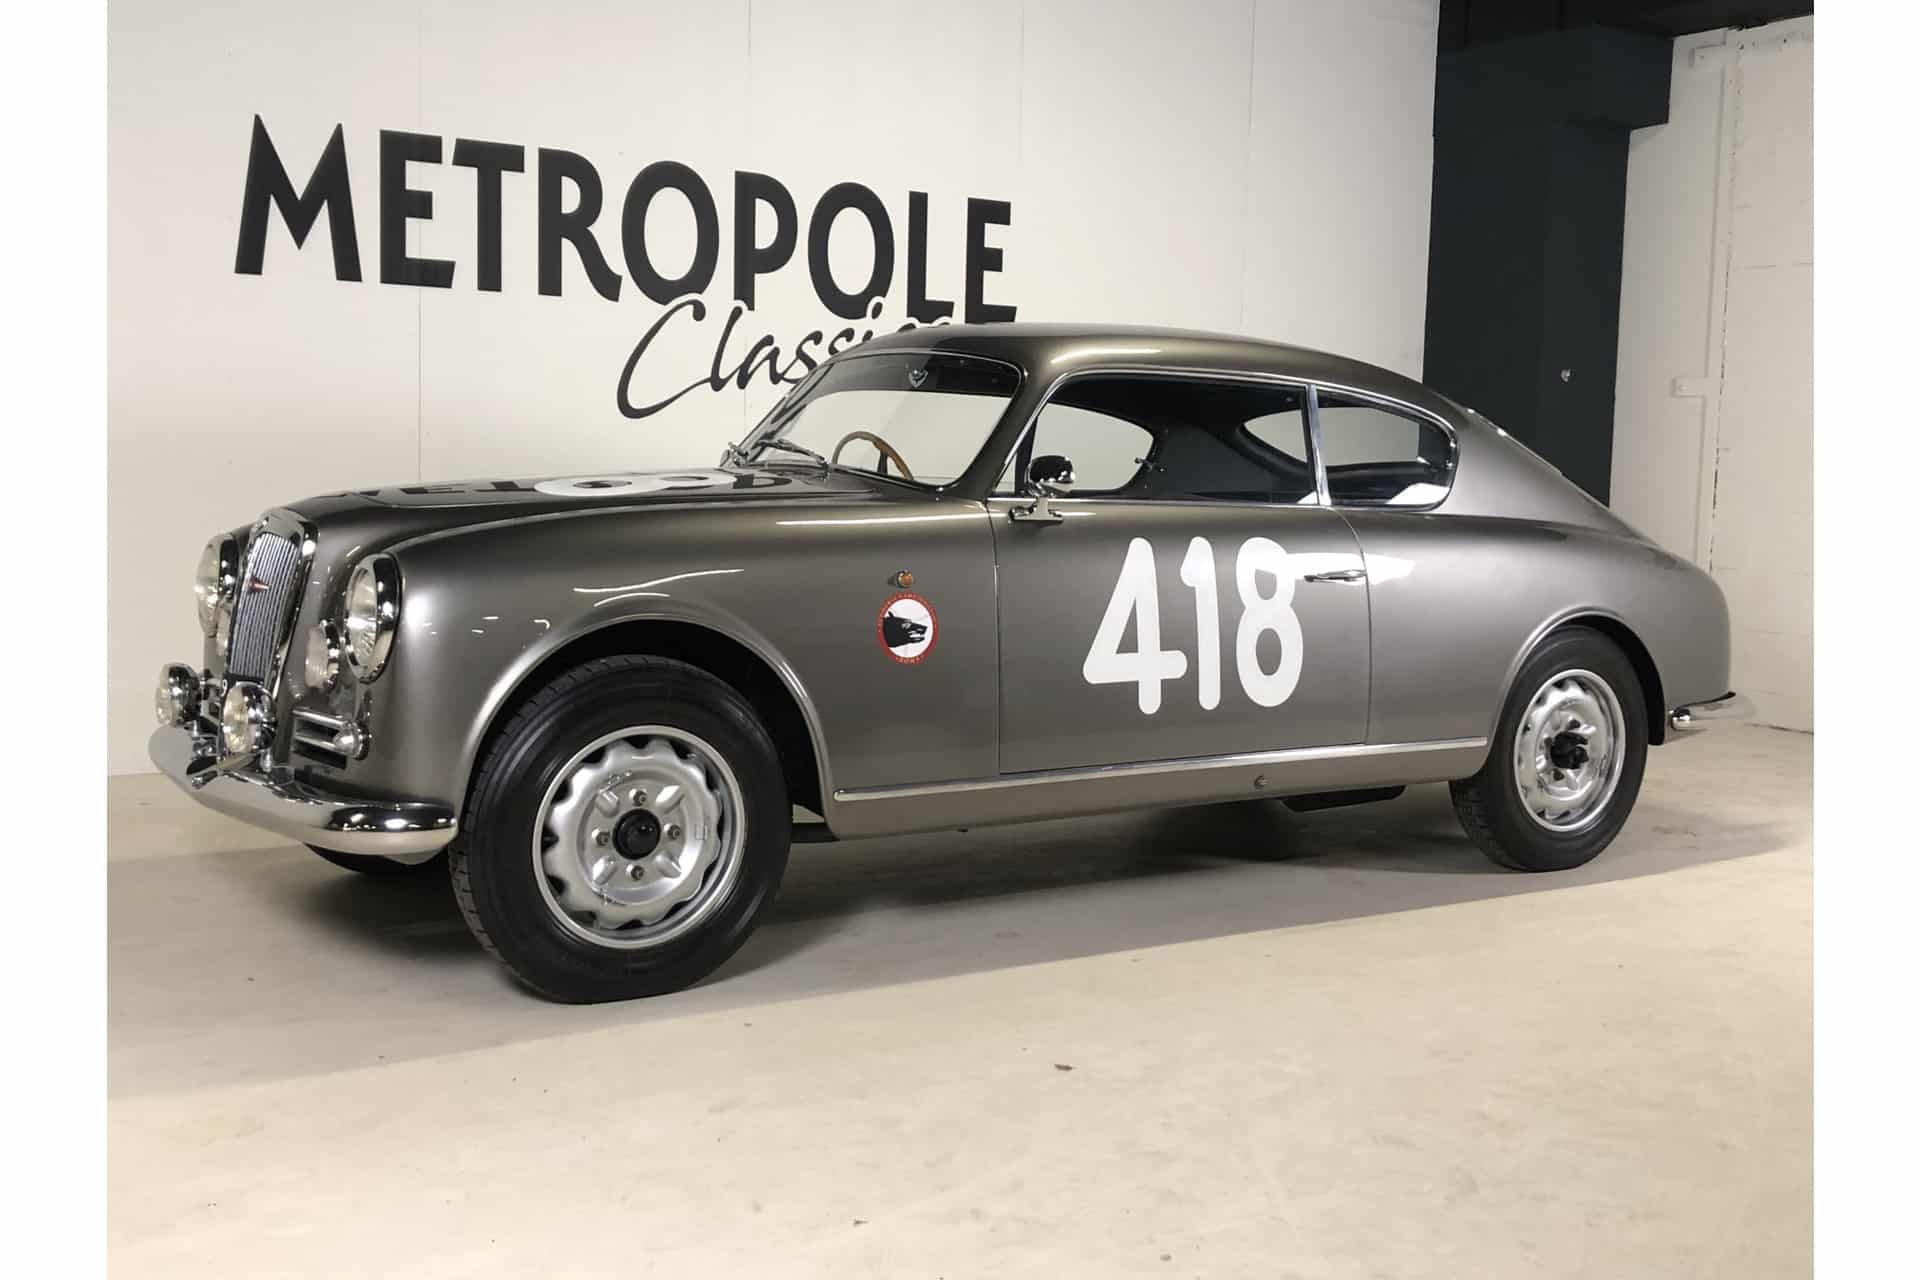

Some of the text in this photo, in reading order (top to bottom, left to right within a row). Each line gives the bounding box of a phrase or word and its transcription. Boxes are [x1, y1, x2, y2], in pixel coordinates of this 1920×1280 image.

[234, 114, 1018, 325] METROPOLE
[617, 298, 949, 419] Class
[1083, 537, 1303, 714] 418
